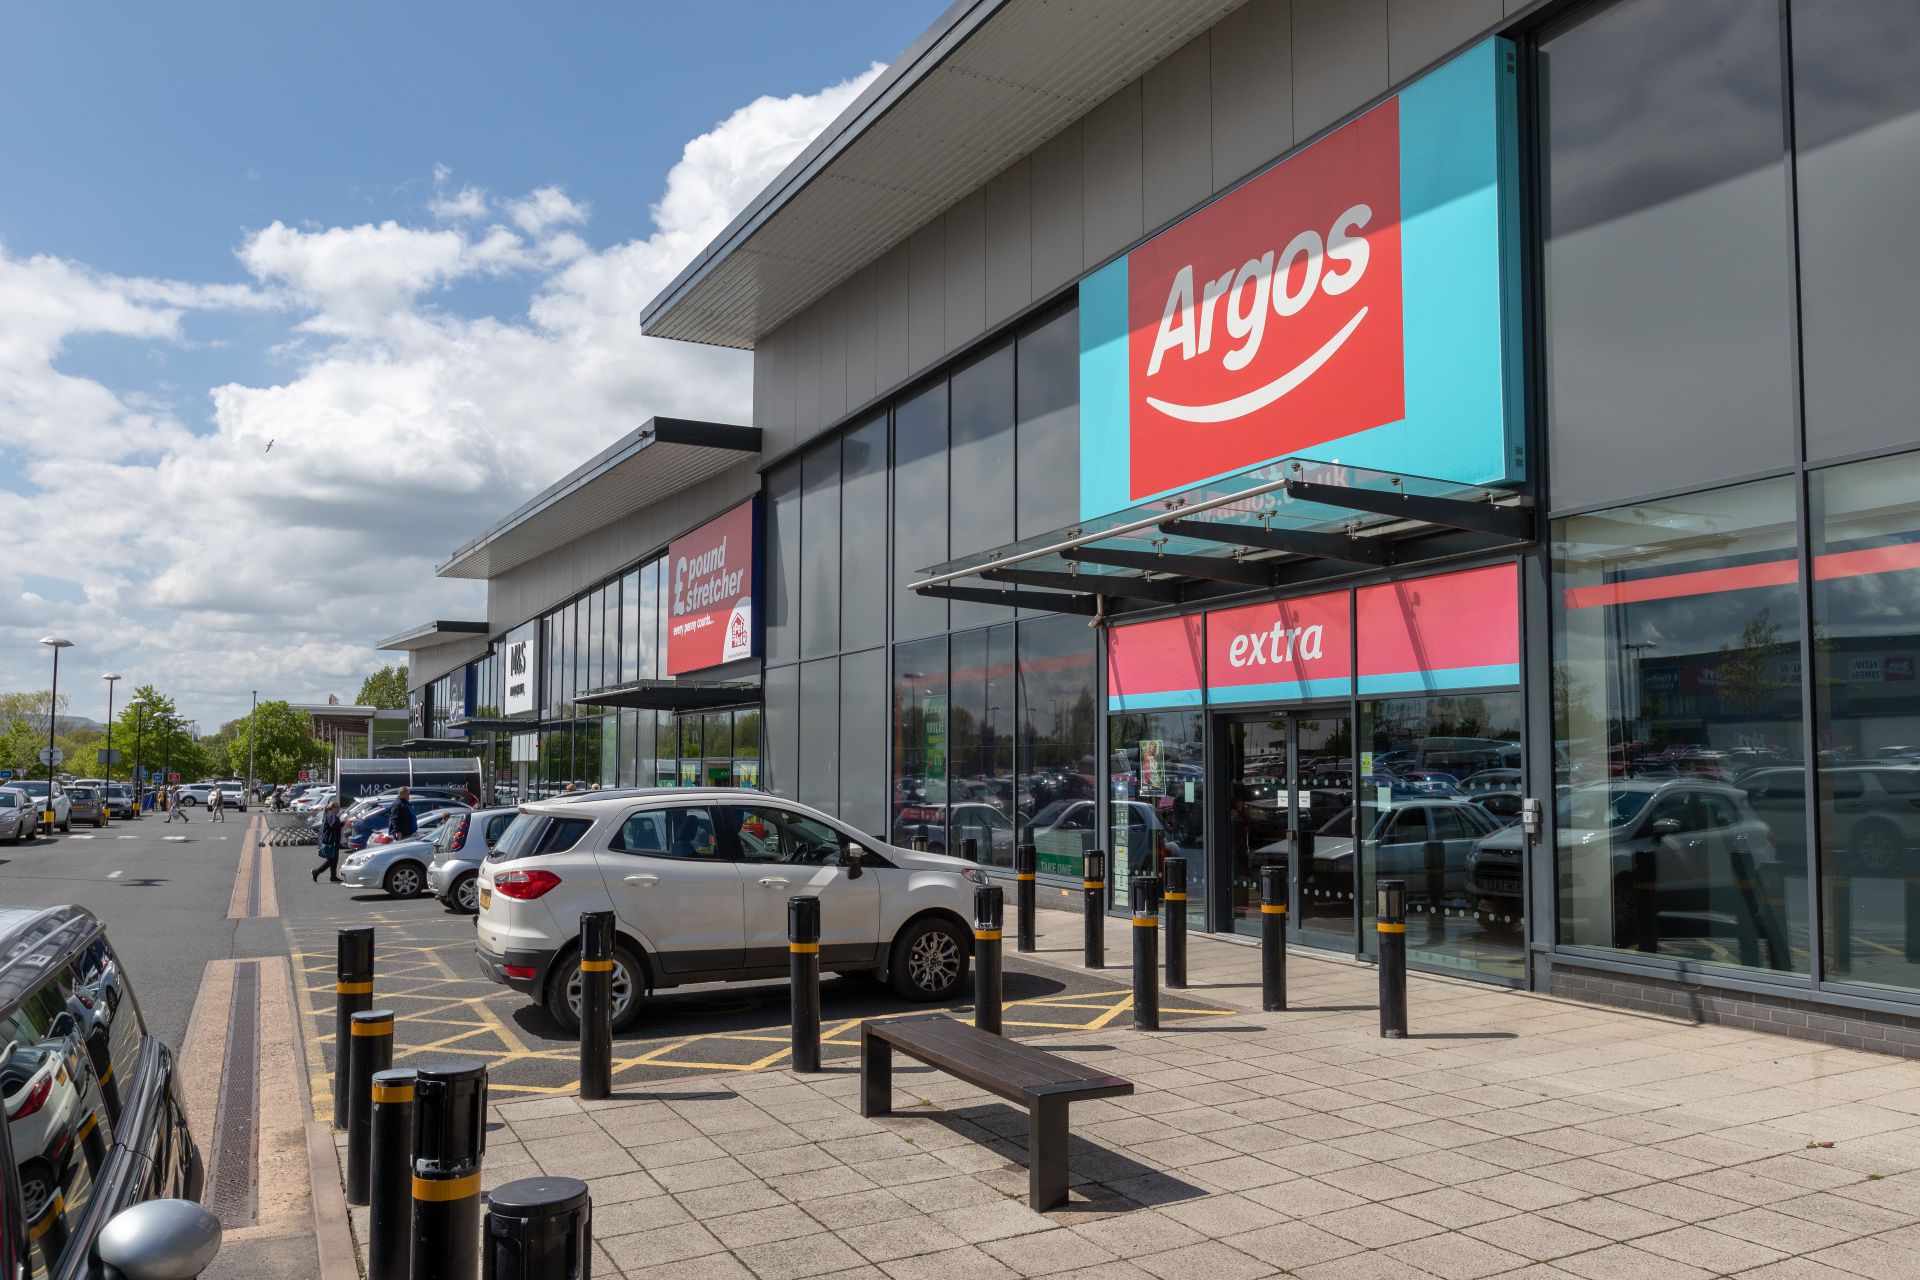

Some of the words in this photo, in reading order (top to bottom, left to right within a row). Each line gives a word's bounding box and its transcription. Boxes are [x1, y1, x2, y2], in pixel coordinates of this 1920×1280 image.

[1146, 203, 1373, 377] Argos
[673, 556, 687, 617] £
[688, 535, 727, 589] pound
[685, 568, 745, 613] stretcher
[673, 626, 684, 637] every
[684, 619, 697, 636] penny
[1229, 620, 1323, 668] extra
[510, 640, 527, 676] M&S
[1040, 861, 1056, 873] TAKE
[1057, 863, 1072, 875] ONE
